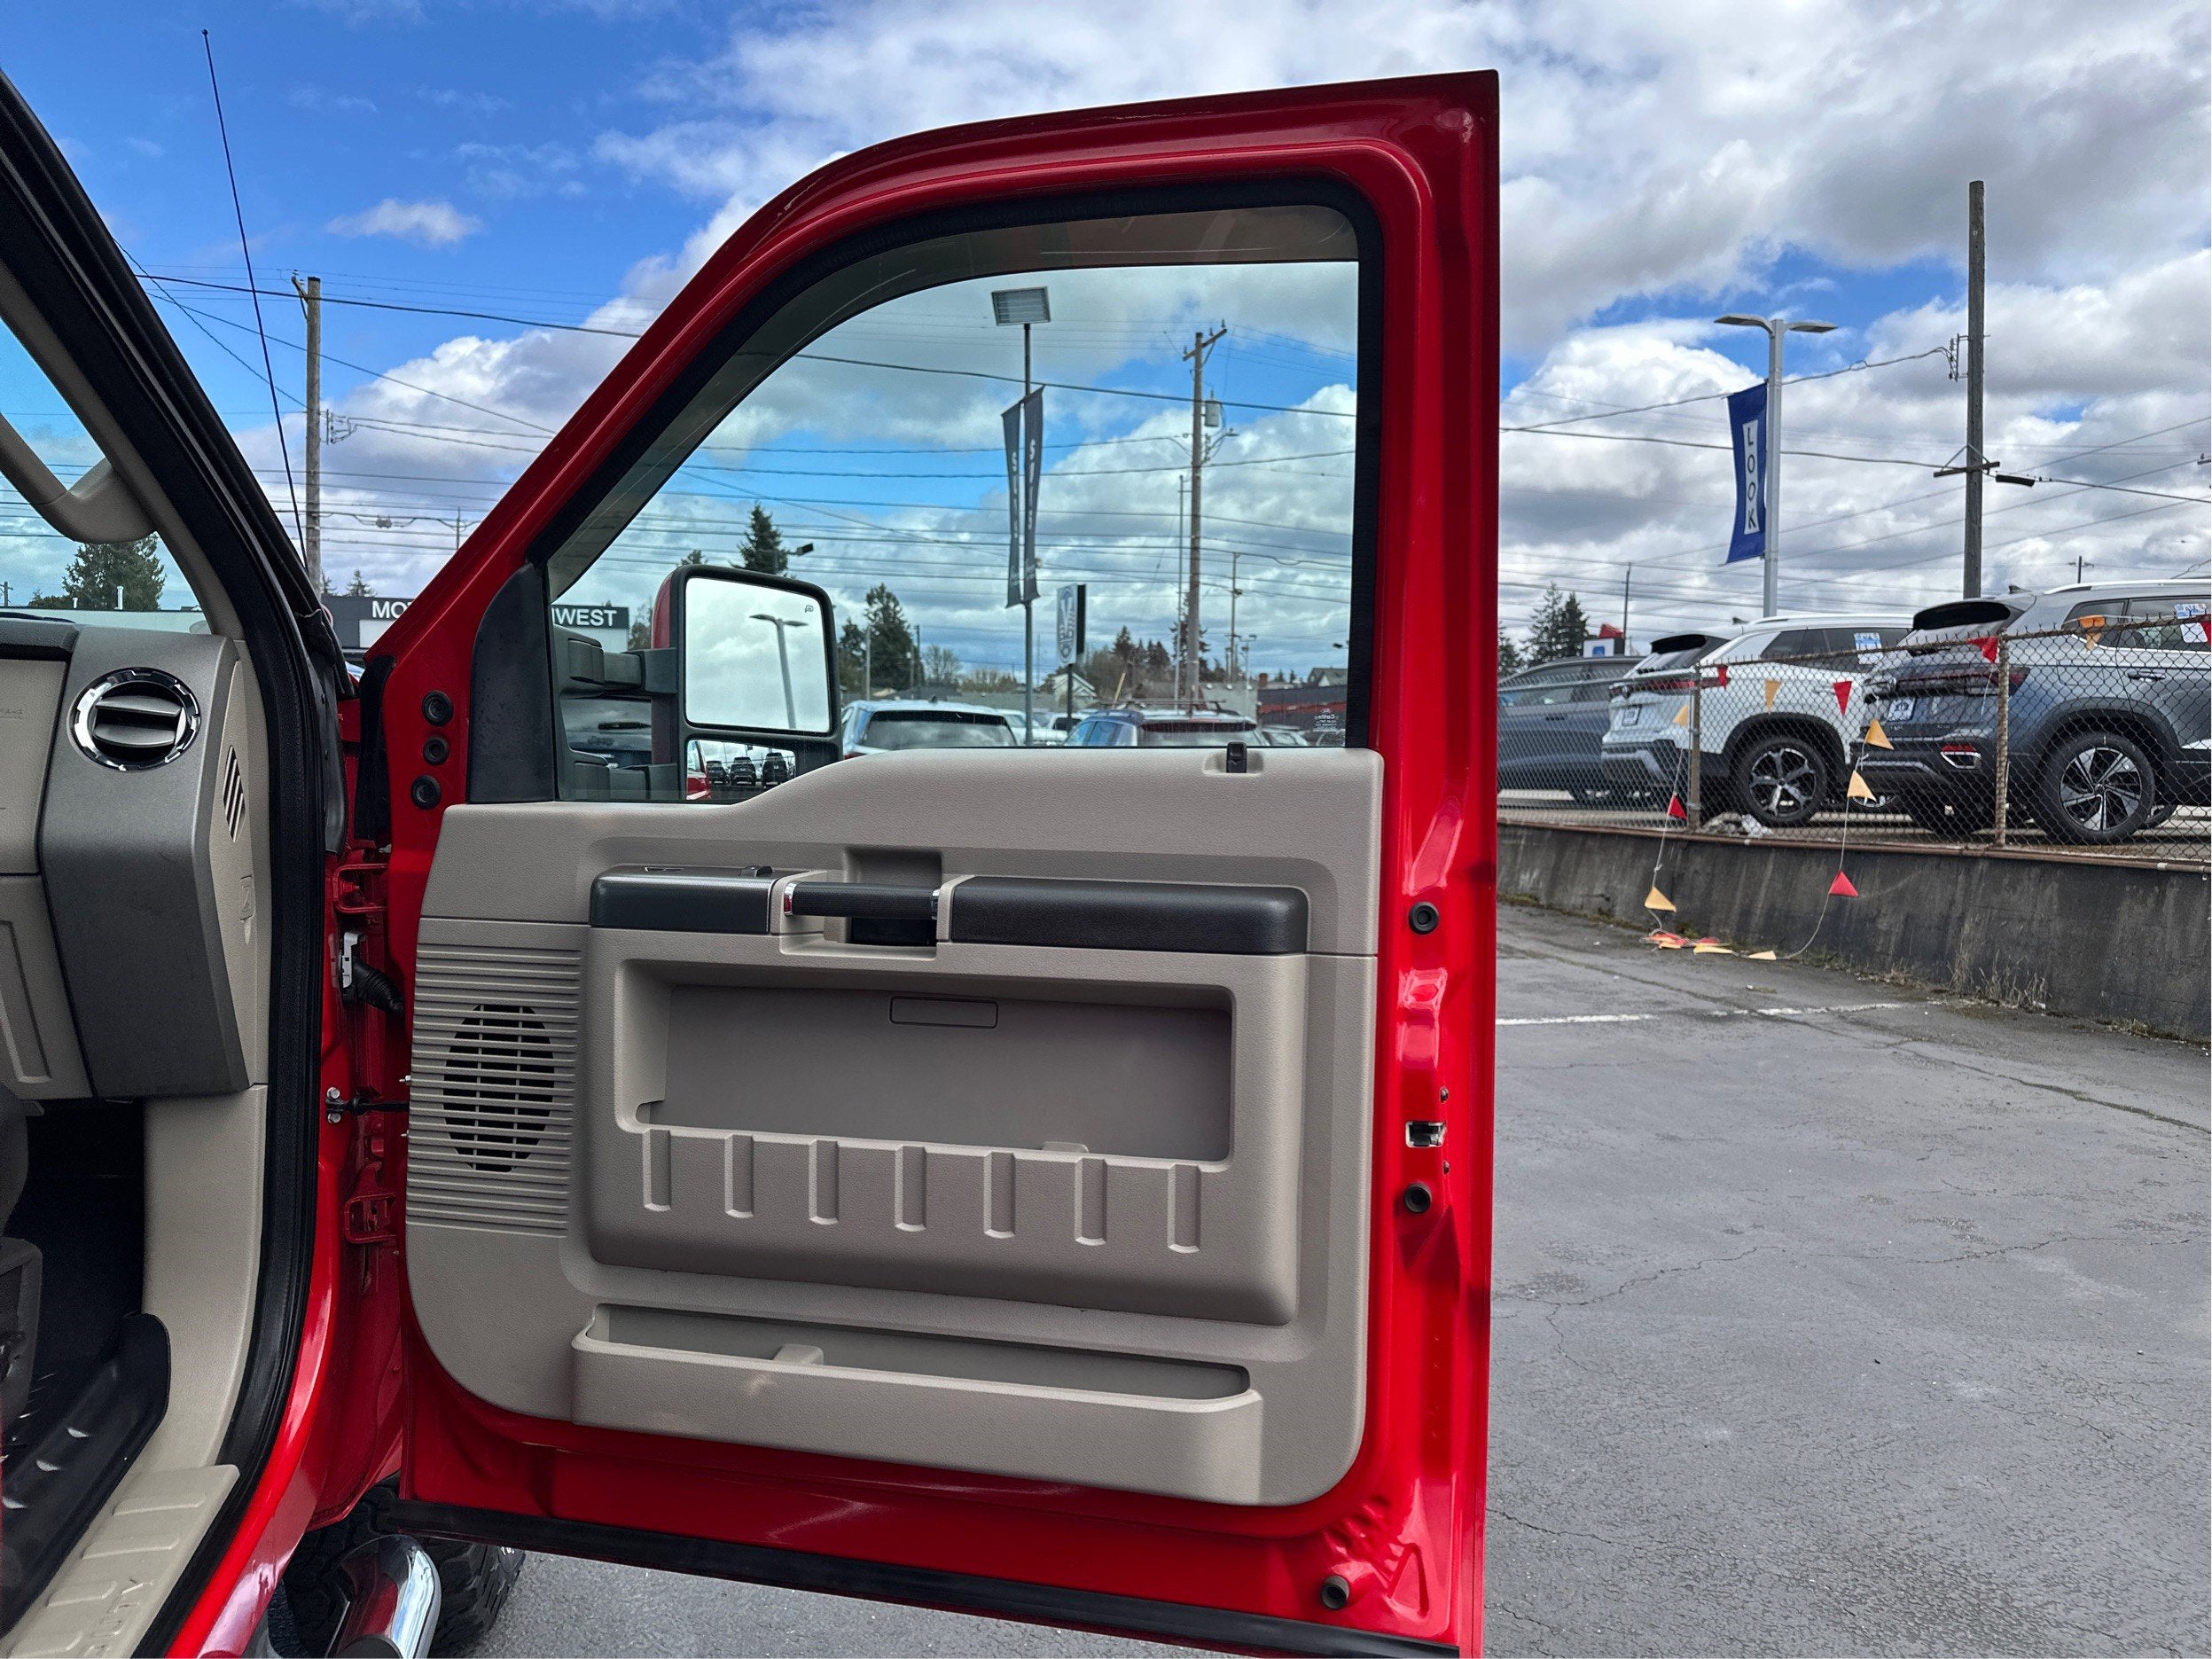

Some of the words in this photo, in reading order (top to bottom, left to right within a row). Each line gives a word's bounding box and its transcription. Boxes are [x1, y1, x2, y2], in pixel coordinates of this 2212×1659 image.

[1747, 427, 1756, 528] LOOK
[372, 600, 412, 619] MO
[551, 606, 617, 627] WEST
